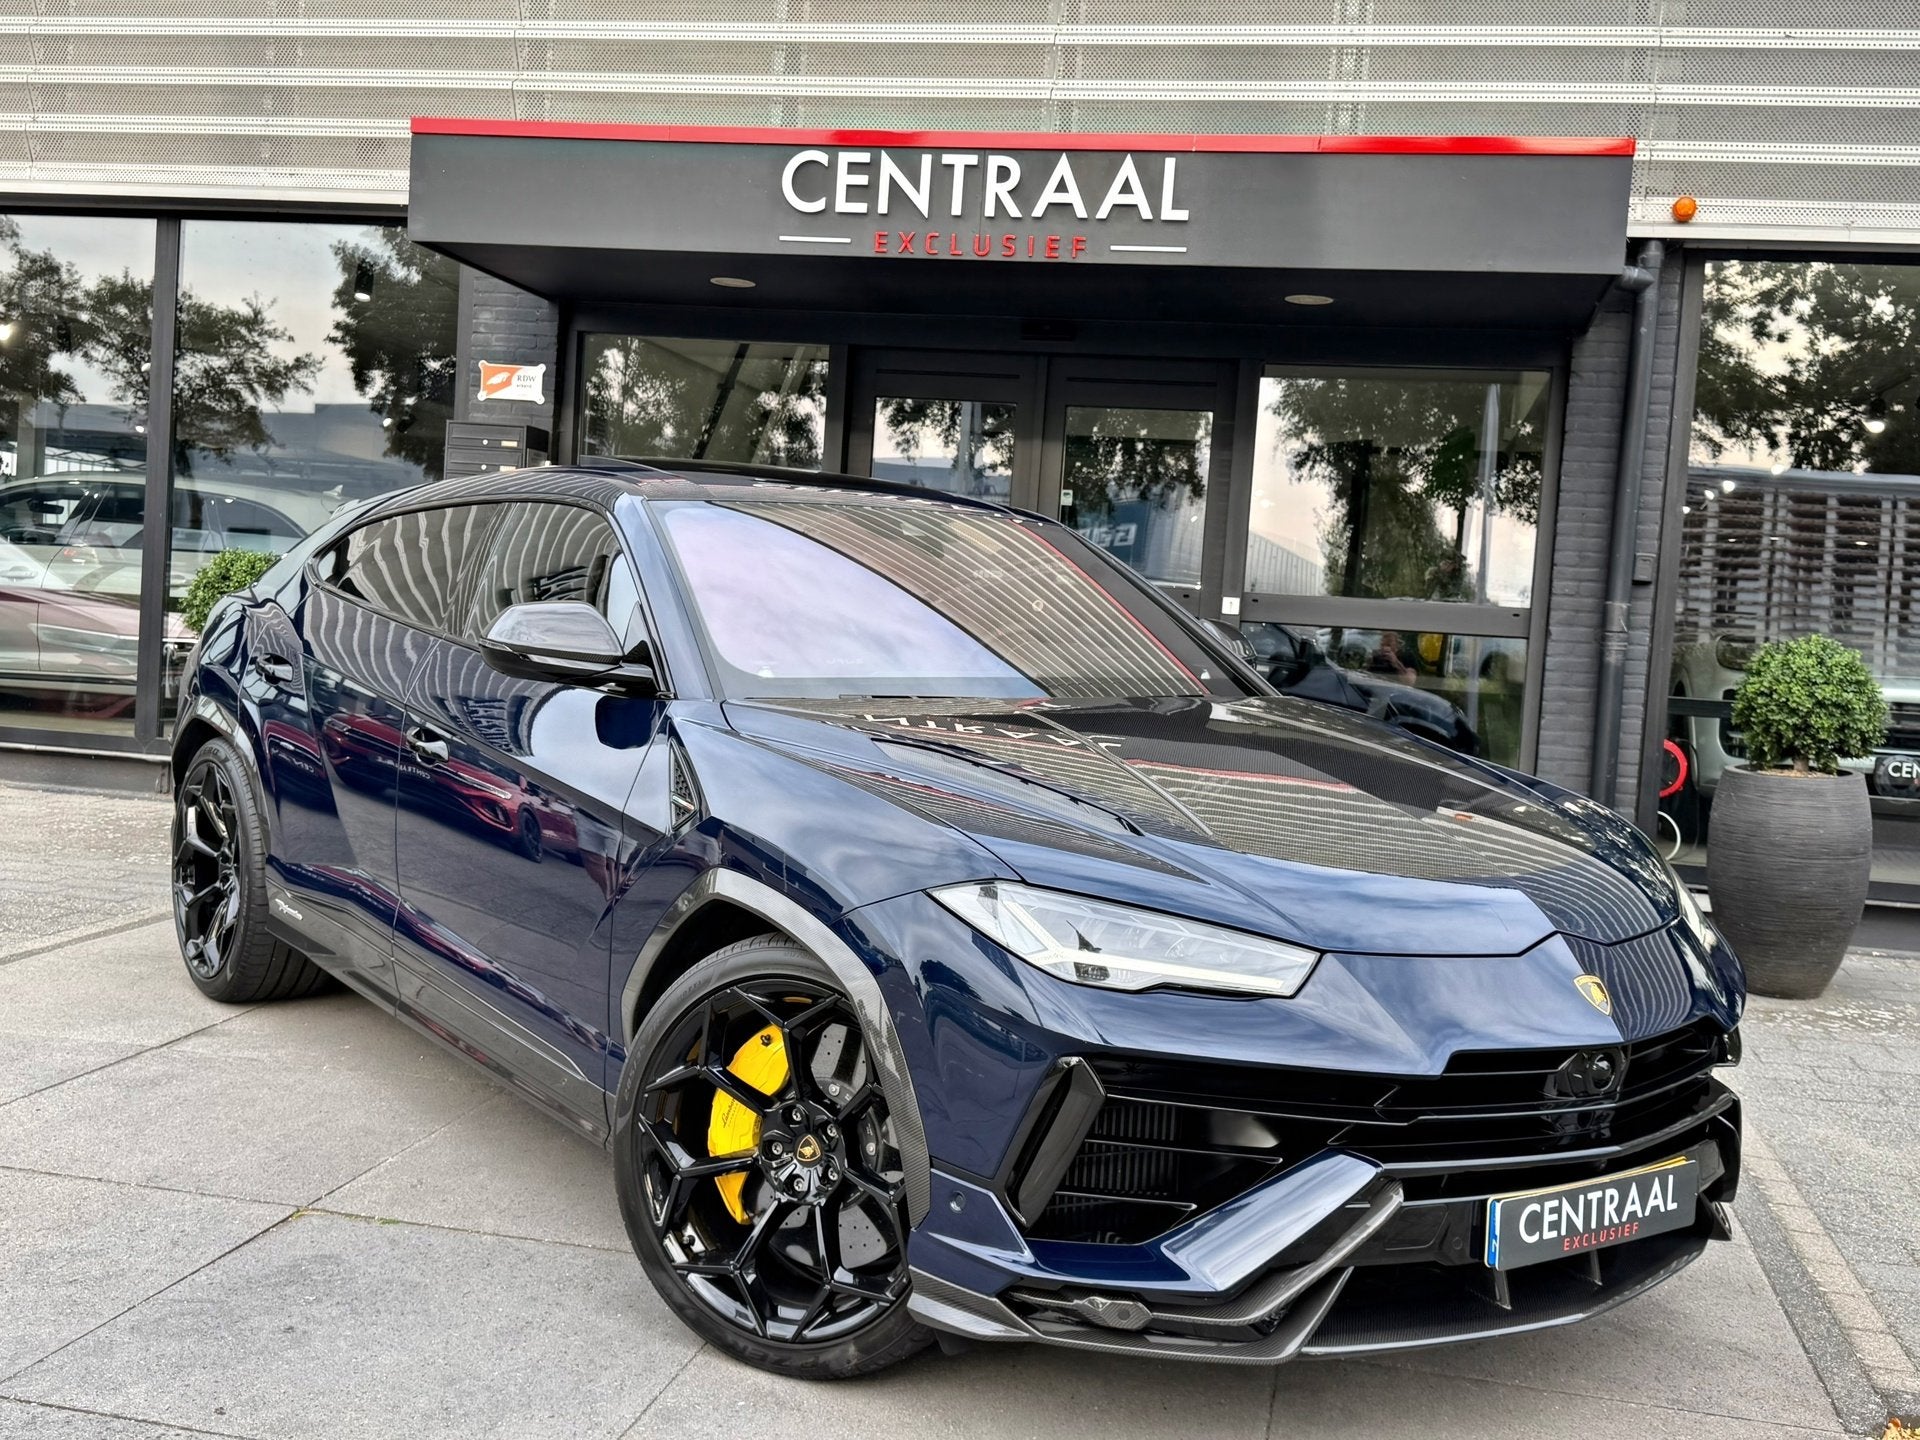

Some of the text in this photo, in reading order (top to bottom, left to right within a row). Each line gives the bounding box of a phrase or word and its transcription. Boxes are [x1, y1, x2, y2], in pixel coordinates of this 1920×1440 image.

[782, 149, 1189, 221] CENTRAAL
[874, 231, 1088, 259] EXCLUSIEF
[1518, 1174, 1678, 1244] CENTRAAL
[1563, 1222, 1639, 1251] EXCLUSIEF
